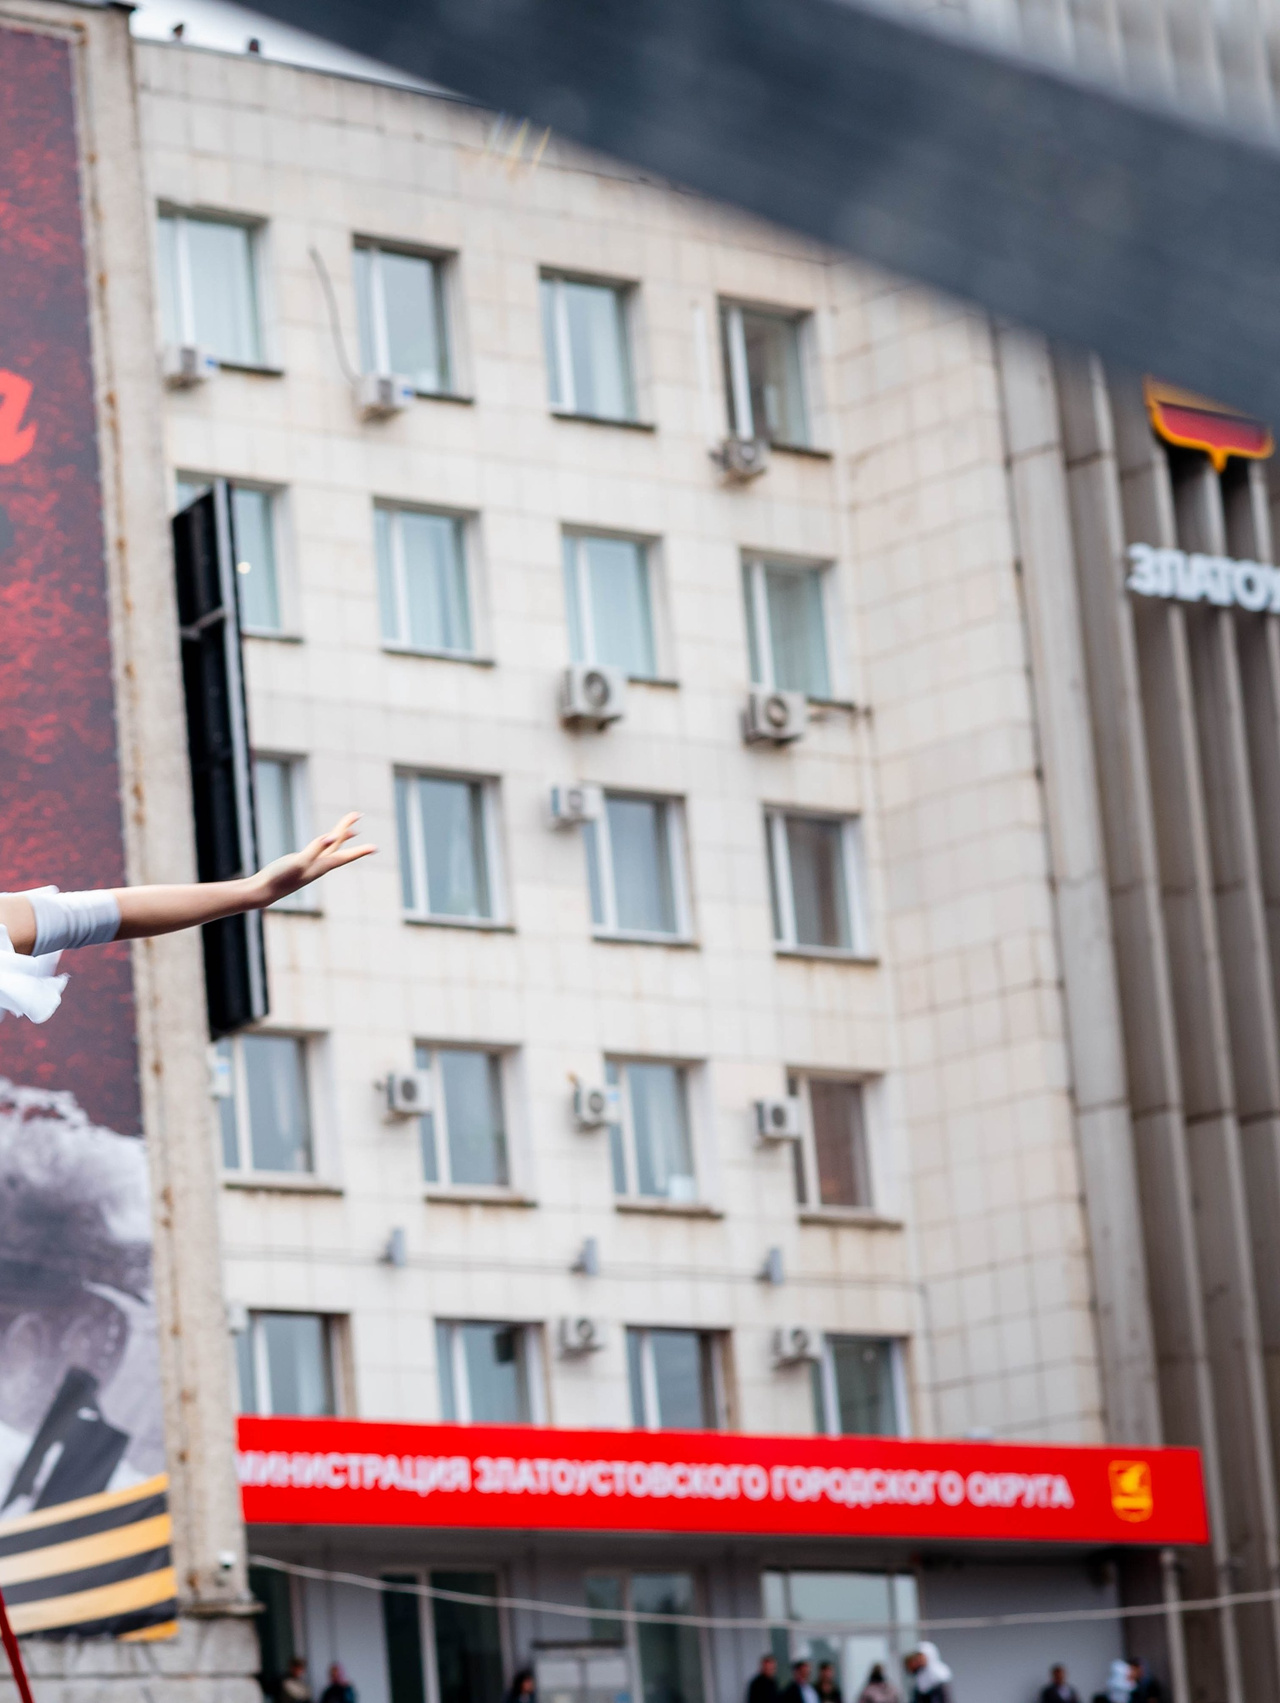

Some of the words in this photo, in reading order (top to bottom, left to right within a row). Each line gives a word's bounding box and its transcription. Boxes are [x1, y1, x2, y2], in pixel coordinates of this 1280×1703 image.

[474, 1456, 769, 1500] ЗЛАТОУСТОВСКОГО
[770, 1465, 963, 1509] ГОРОДСКОГО
[965, 1471, 1076, 1509] ОКРУГА
